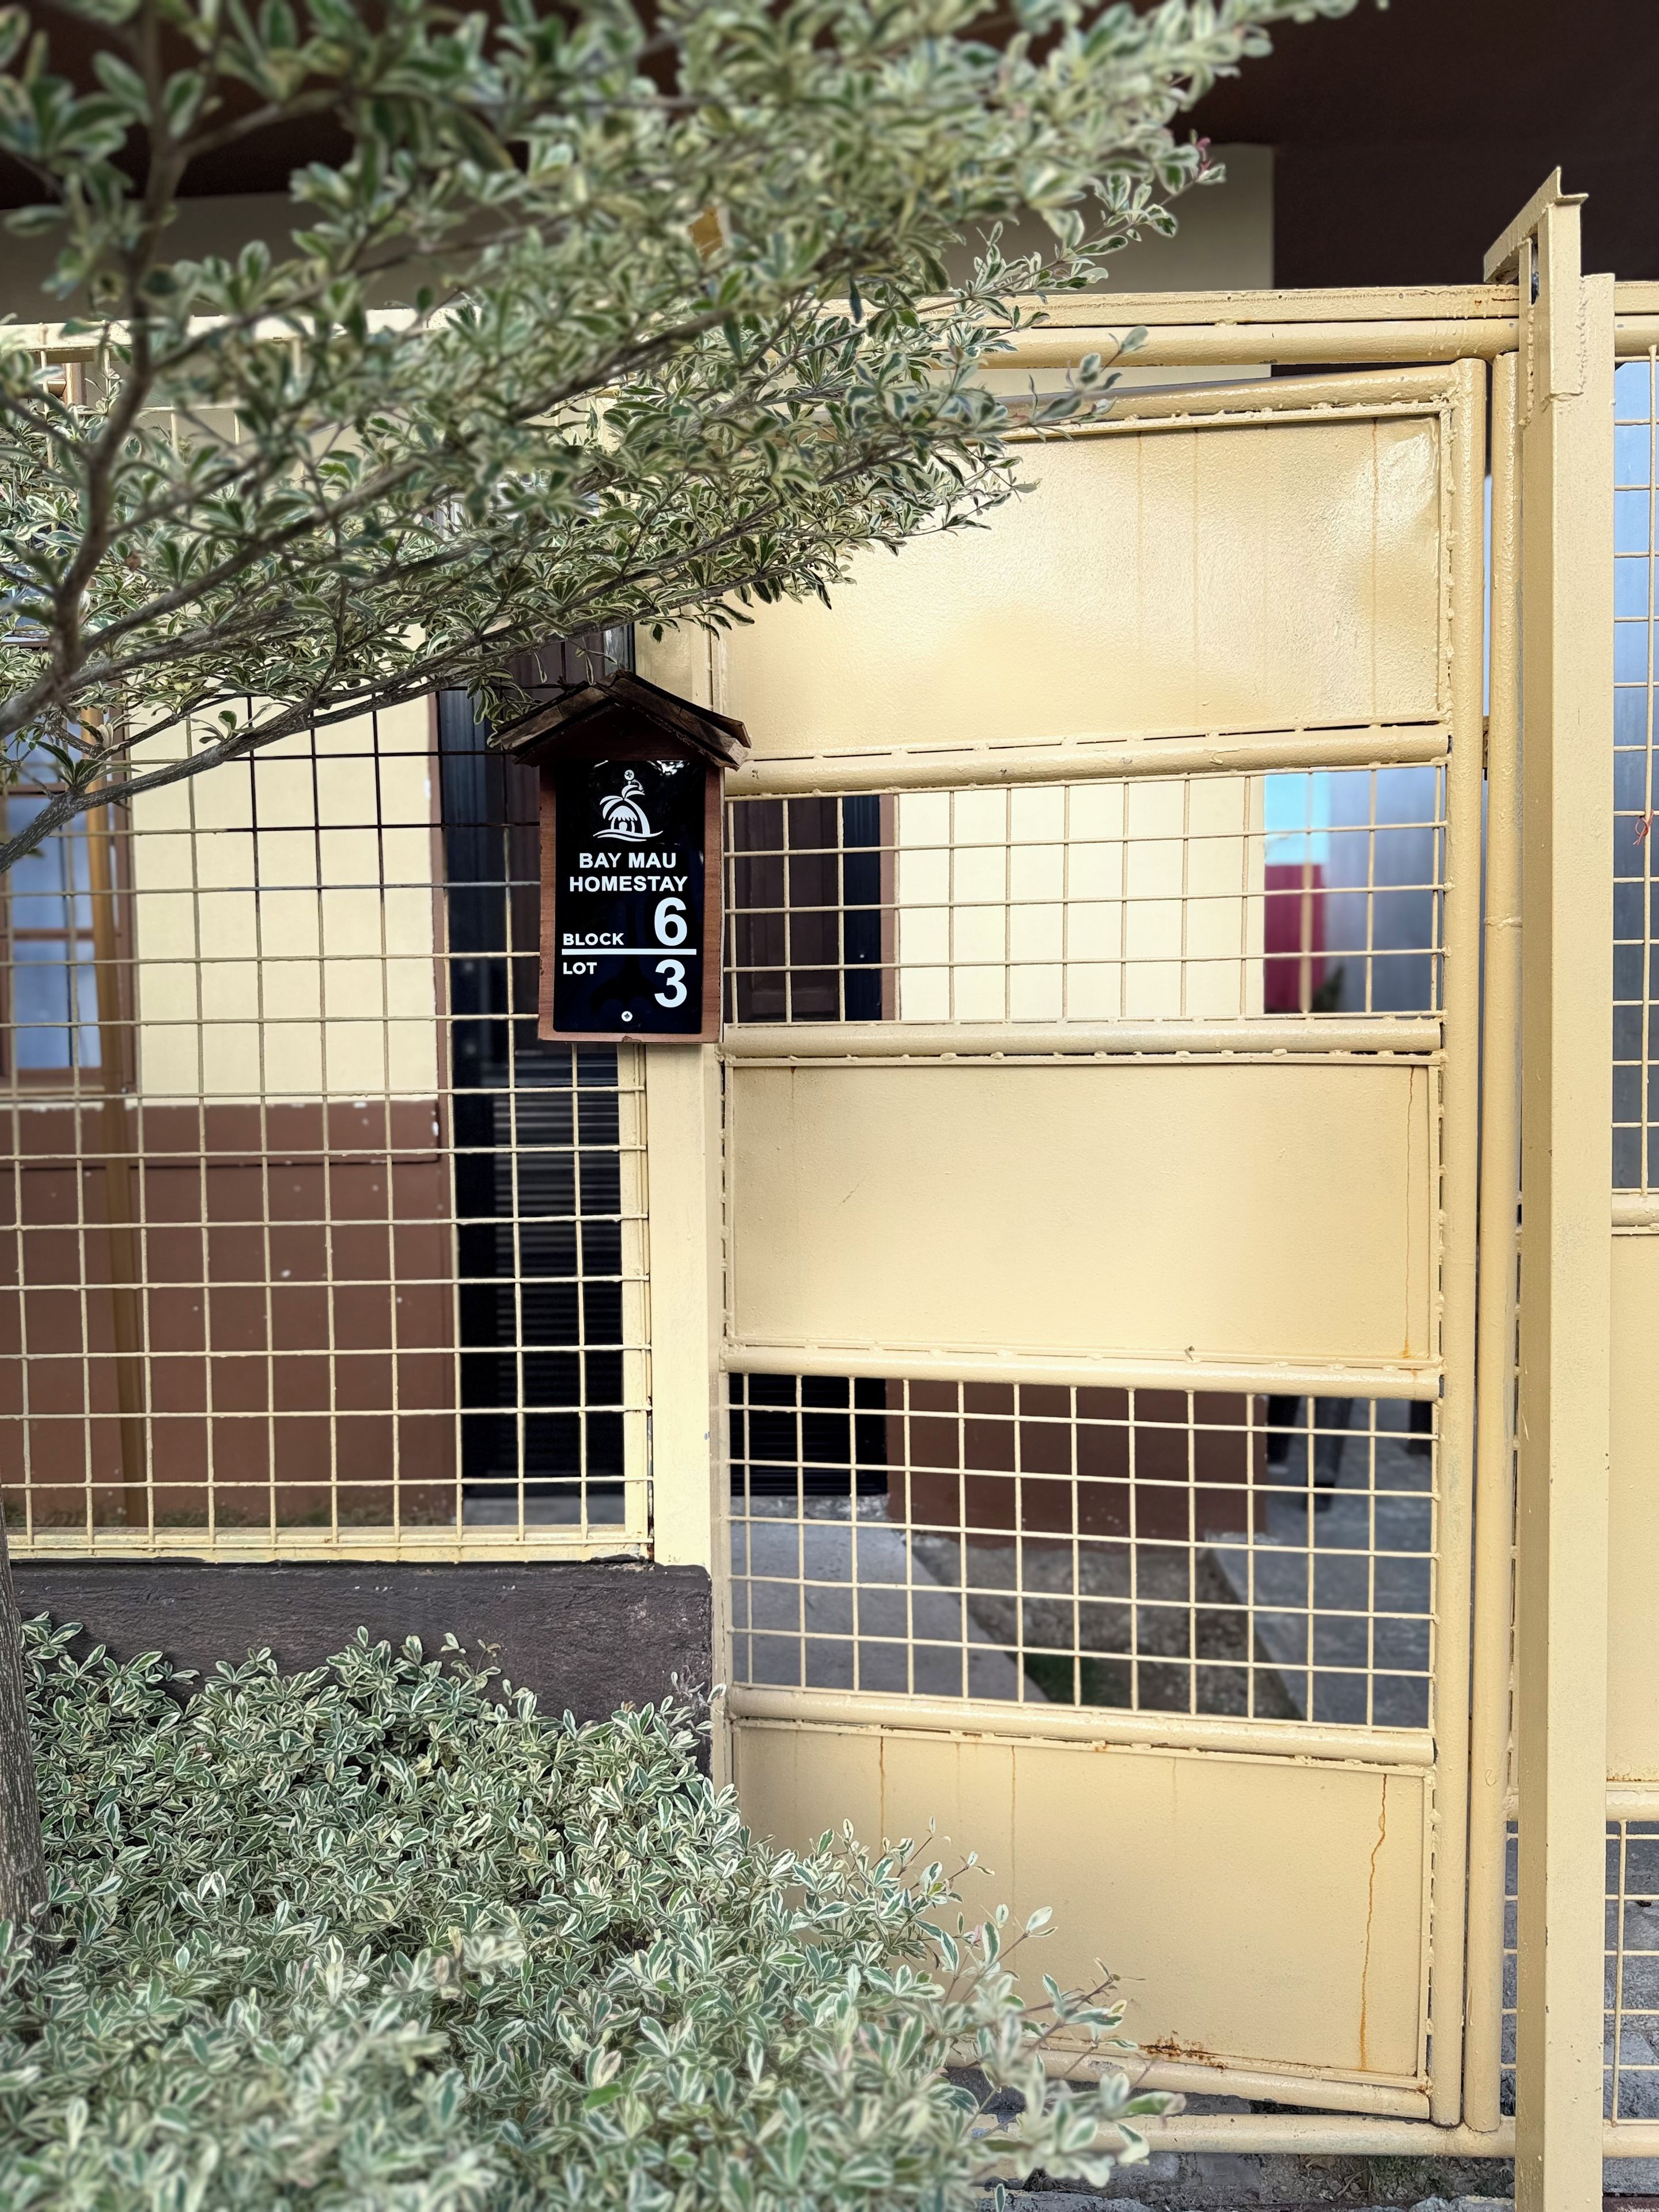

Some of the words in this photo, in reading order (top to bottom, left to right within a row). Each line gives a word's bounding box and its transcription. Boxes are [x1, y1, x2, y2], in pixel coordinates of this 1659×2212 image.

[579, 852, 622, 868] BAY
[628, 852, 676, 869] MAU
[570, 876, 688, 892] HOMESTAY
[563, 933, 624, 946] BLOCK
[654, 897, 687, 946] 6
[563, 961, 597, 975] LOT
[654, 959, 687, 1008] 3
